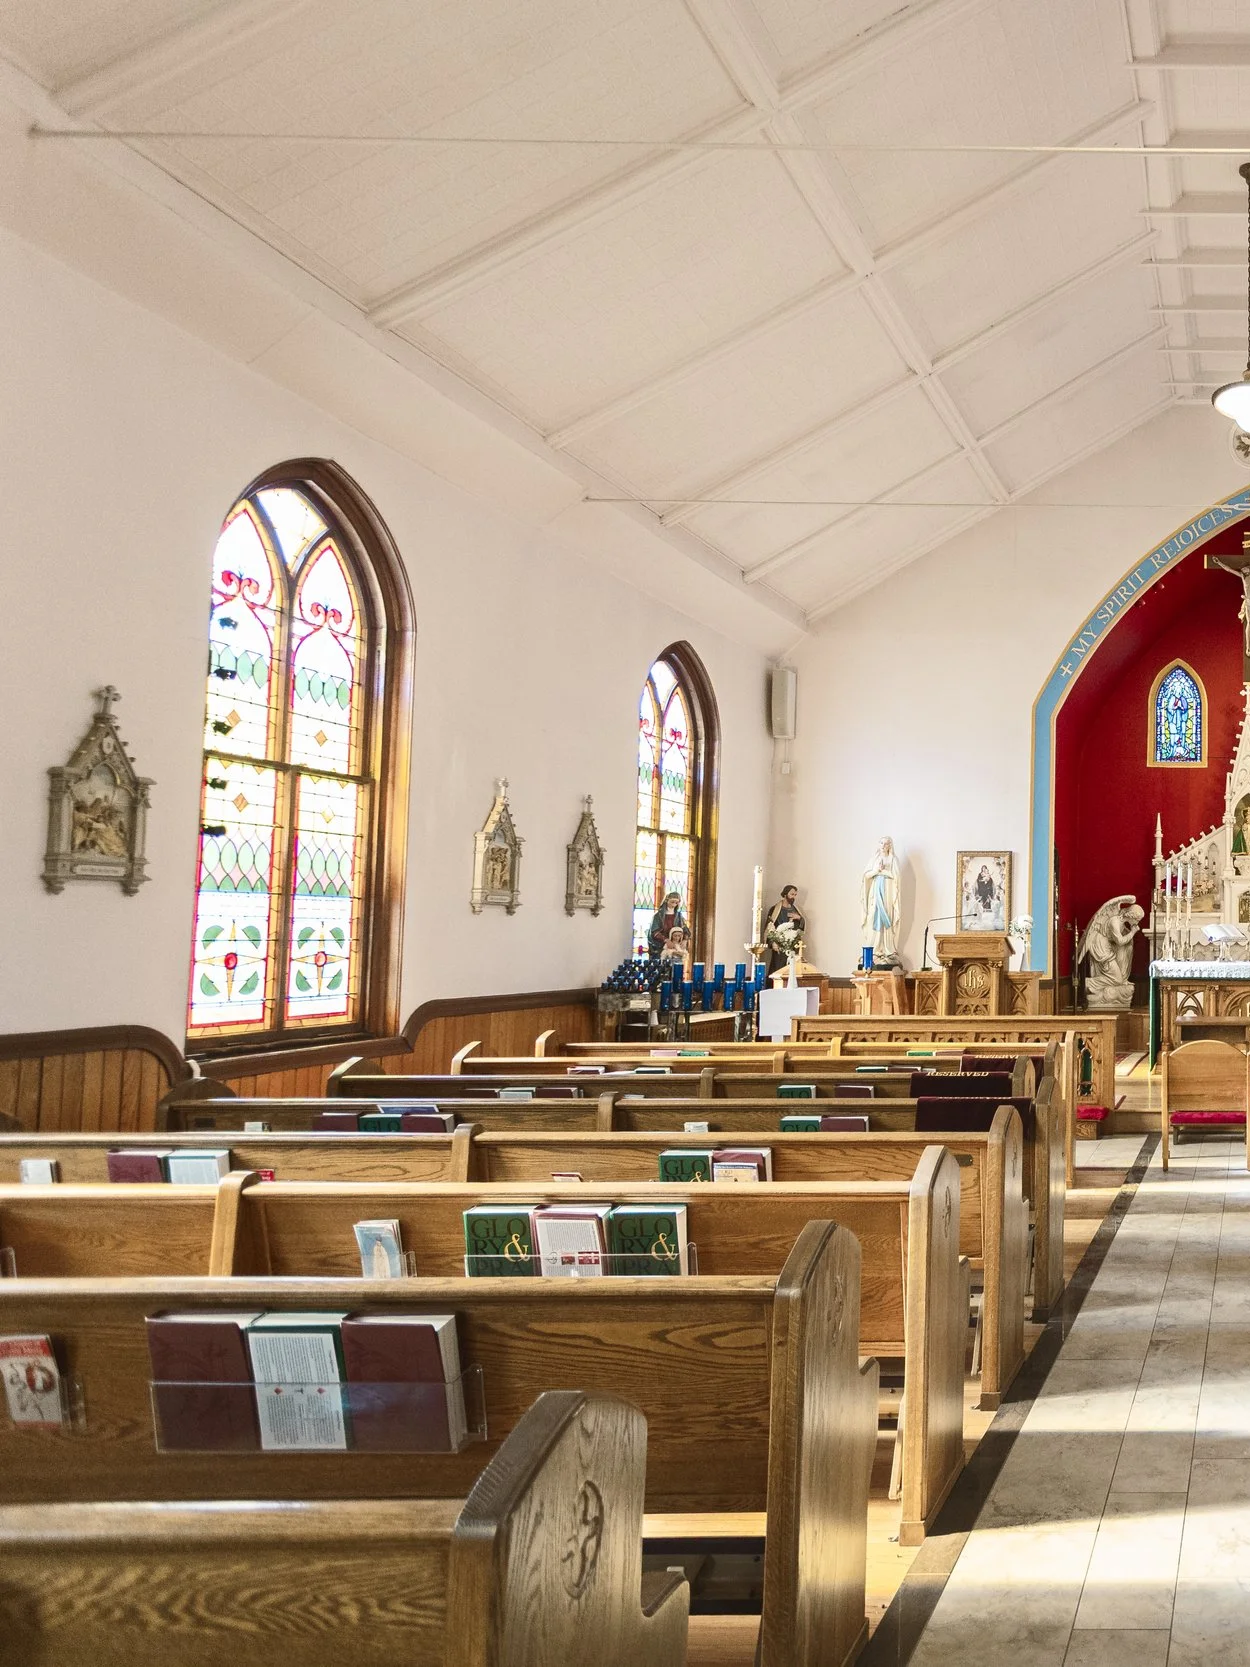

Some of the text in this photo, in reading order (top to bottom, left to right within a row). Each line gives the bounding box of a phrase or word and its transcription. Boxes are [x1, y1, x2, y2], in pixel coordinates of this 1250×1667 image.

[1072, 624, 1098, 660] MY
[1097, 568, 1146, 625] SPIRIT
[1150, 505, 1233, 569] REJOICES
[664, 1160, 707, 1175] GLO
[471, 1218, 527, 1239] GLO
[618, 1217, 674, 1238] GLO
[474, 1239, 506, 1256] RY
[504, 1233, 530, 1262] &
[621, 1238, 653, 1256] RY
[651, 1232, 678, 1261] &
